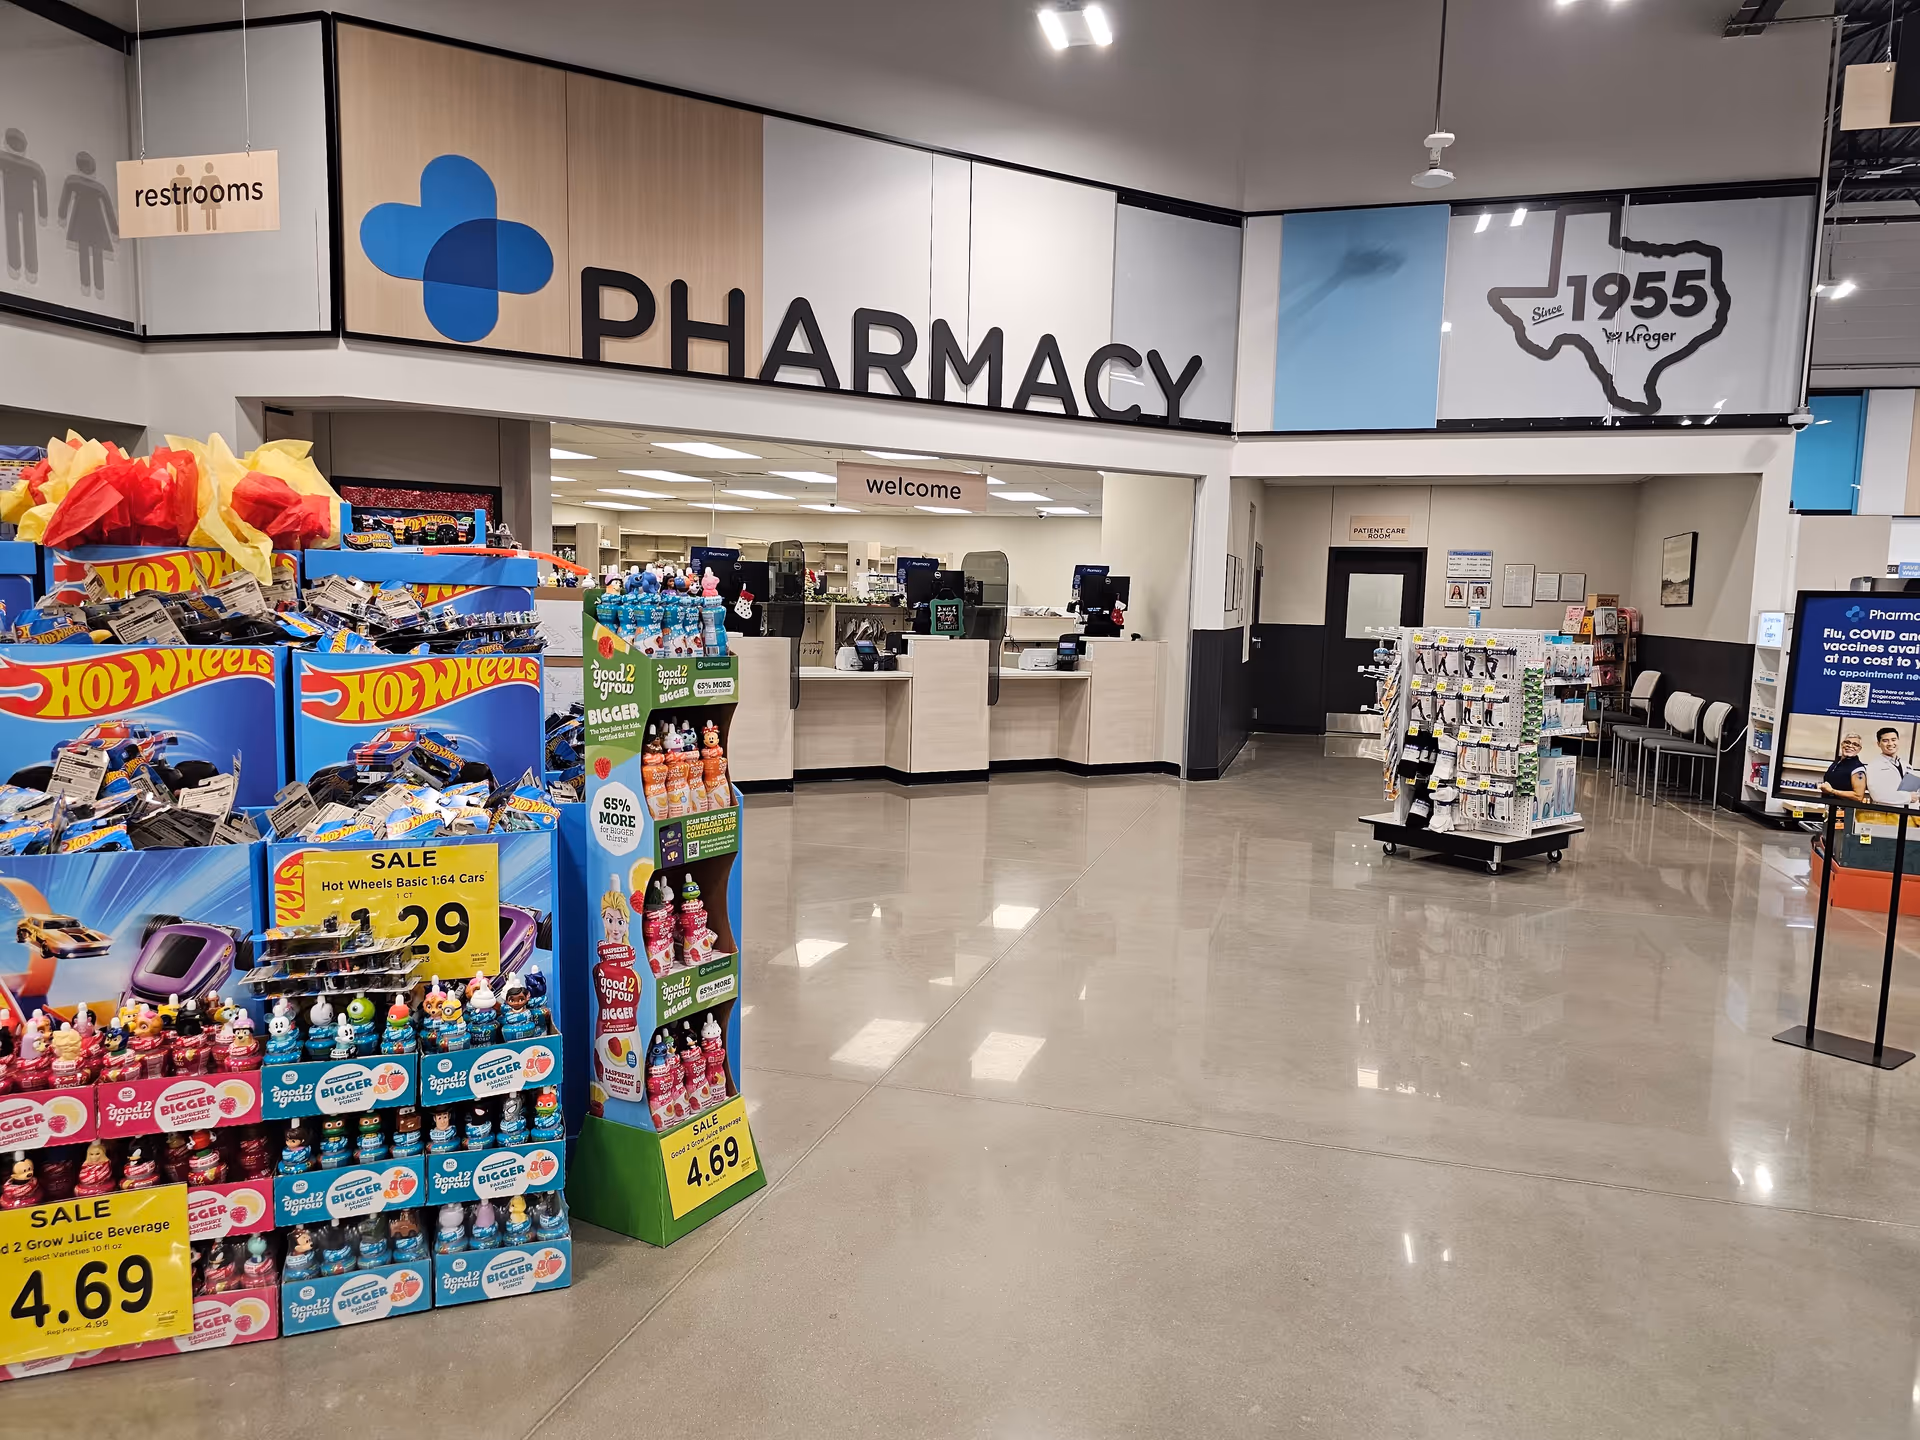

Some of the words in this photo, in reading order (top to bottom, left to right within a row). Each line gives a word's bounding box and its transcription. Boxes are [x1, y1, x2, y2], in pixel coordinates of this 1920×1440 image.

[134, 179, 264, 207] restrooms
[1532, 304, 1563, 322] Since
[1566, 269, 1708, 322] 1955
[581, 266, 1203, 425] PHARMACY
[1626, 324, 1677, 350] Kroger
[866, 476, 962, 500] welcome
[1823, 628, 1846, 641] Flu,
[1849, 629, 1896, 641] COVID
[1823, 642, 1885, 653] vaccines
[1824, 654, 1839, 664] at
[1842, 655, 1860, 665] no
[1863, 656, 1894, 666] cost
[1897, 657, 1912, 667] to
[1823, 668, 1837, 676] No
[1839, 669, 1904, 680] appointment
[600, 681, 634, 701] grow
[663, 677, 687, 691] grow
[697, 682, 711, 690] 65%
[713, 680, 732, 689] MORE
[659, 687, 690, 704] BIGGER
[587, 702, 641, 726] BIGGER
[589, 728, 600, 736] The
[603, 797, 631, 812] 65%
[598, 811, 636, 828] MORE
[686, 819, 723, 833] DOWNLOAD
[723, 816, 737, 825] OUR
[600, 825, 609, 833] for
[609, 827, 635, 837] BIGGER
[605, 834, 629, 844] thirsts!
[686, 826, 724, 840] COLLECTORS
[724, 823, 737, 832] APP
[371, 850, 437, 869] SALE
[321, 880, 344, 892] Hot
[348, 878, 393, 890] Wheels
[396, 876, 428, 888] Basic
[432, 874, 456, 886] 1:64
[459, 872, 485, 884] Cars
[351, 901, 470, 955] 129
[714, 977, 732, 990] MORE
[605, 989, 634, 1004] grow
[667, 987, 691, 1005] grow
[601, 1006, 634, 1020] BIGGER
[663, 997, 693, 1019] BIGGER
[473, 1061, 522, 1084] BIGGER
[604, 1067, 635, 1081] RASPBERRY
[605, 1074, 635, 1087] LEMONADE
[320, 1078, 373, 1099] BIGGER
[436, 1081, 466, 1096] grow
[160, 1095, 217, 1117] BIGGER
[279, 1094, 313, 1108] grow
[115, 1111, 152, 1127] grow
[170, 1108, 211, 1122] RASPBERRY
[172, 1114, 211, 1127] LEMONADE
[692, 1113, 719, 1136] SALE
[670, 1145, 686, 1159] Good
[686, 1143, 691, 1151] 2
[691, 1136, 705, 1148] Grow
[705, 1130, 718, 1141] Juice
[718, 1116, 742, 1133] Beverage
[687, 1136, 740, 1187] 4.69
[477, 1164, 526, 1185] BIGGER
[331, 1182, 382, 1205] BIGGER
[440, 1180, 471, 1195] grow
[30, 1199, 112, 1229] SALE
[290, 1201, 323, 1217] grow
[13, 1241, 22, 1253] 2
[27, 1236, 64, 1250] Grow
[68, 1230, 103, 1244] Juice
[108, 1220, 170, 1237] Beverage
[23, 1253, 50, 1264] Select
[53, 1247, 90, 1259] Varieties
[93, 1245, 102, 1253] 10
[104, 1243, 110, 1251] fl
[486, 1262, 534, 1284] BIGGER
[10, 1254, 154, 1328] 4.69
[449, 1280, 479, 1295] grow
[337, 1286, 389, 1310] BIGGER
[298, 1307, 330, 1323] grow
[85, 1319, 109, 1329] 4.99
[187, 1326, 227, 1342] RASPBERRY
[189, 1332, 227, 1346] LEMONADE
